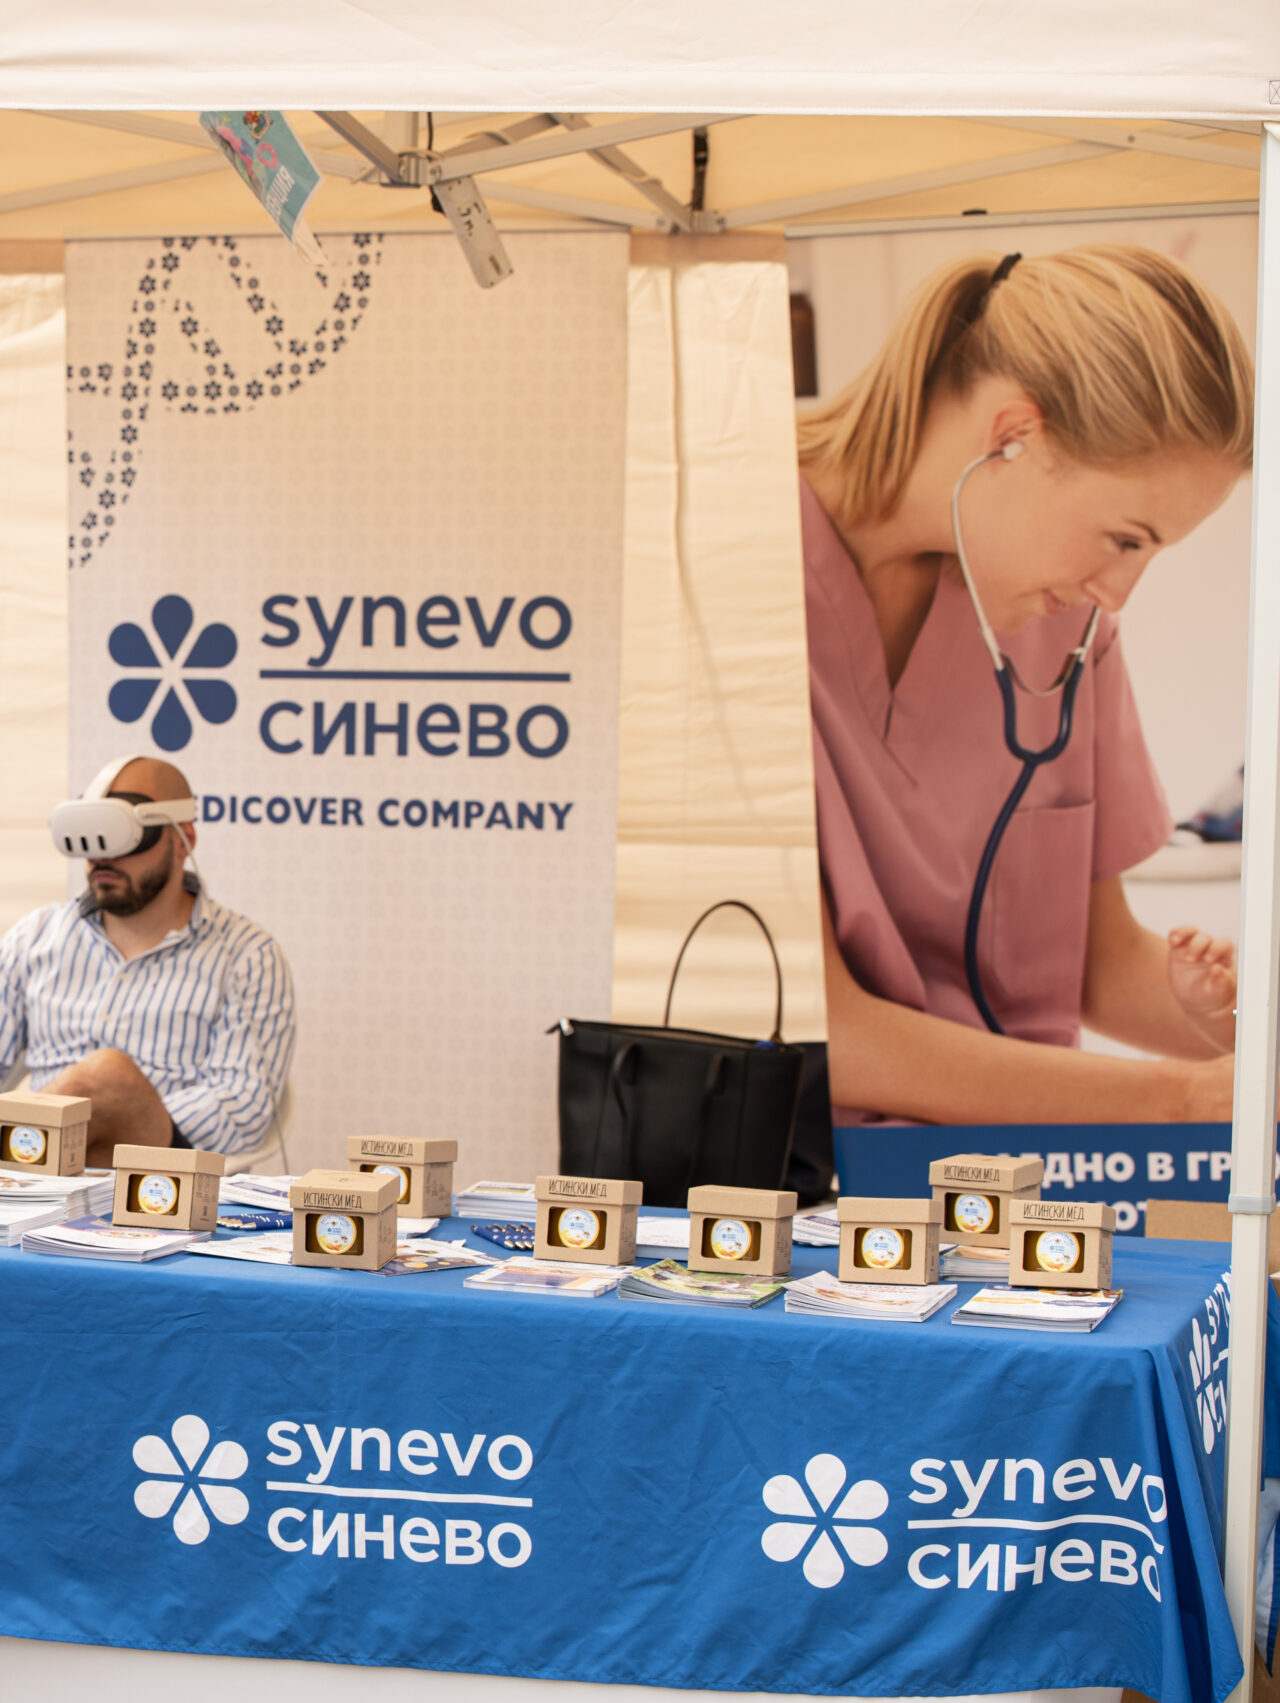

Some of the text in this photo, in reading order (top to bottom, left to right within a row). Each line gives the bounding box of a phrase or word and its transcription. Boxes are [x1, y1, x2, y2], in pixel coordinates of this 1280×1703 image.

[259, 593, 574, 668] synevo
[194, 795, 574, 831] DICOVER COMPANY
[361, 1139, 414, 1156] ИСТИНСКИ МЕД
[944, 1164, 1001, 1182] ИСТИНСКИ МЕД
[1146, 1151, 1175, 1182] В
[303, 1191, 362, 1209] ИСТИНСКИ МЕД
[548, 1179, 608, 1198] ИСТИНСКИ МЕД
[1023, 1202, 1066, 1219] ИСТИНСКИ
[1065, 1205, 1085, 1221] МЕД
[266, 1420, 534, 1484] synevo
[907, 1456, 1168, 1524] synevo
